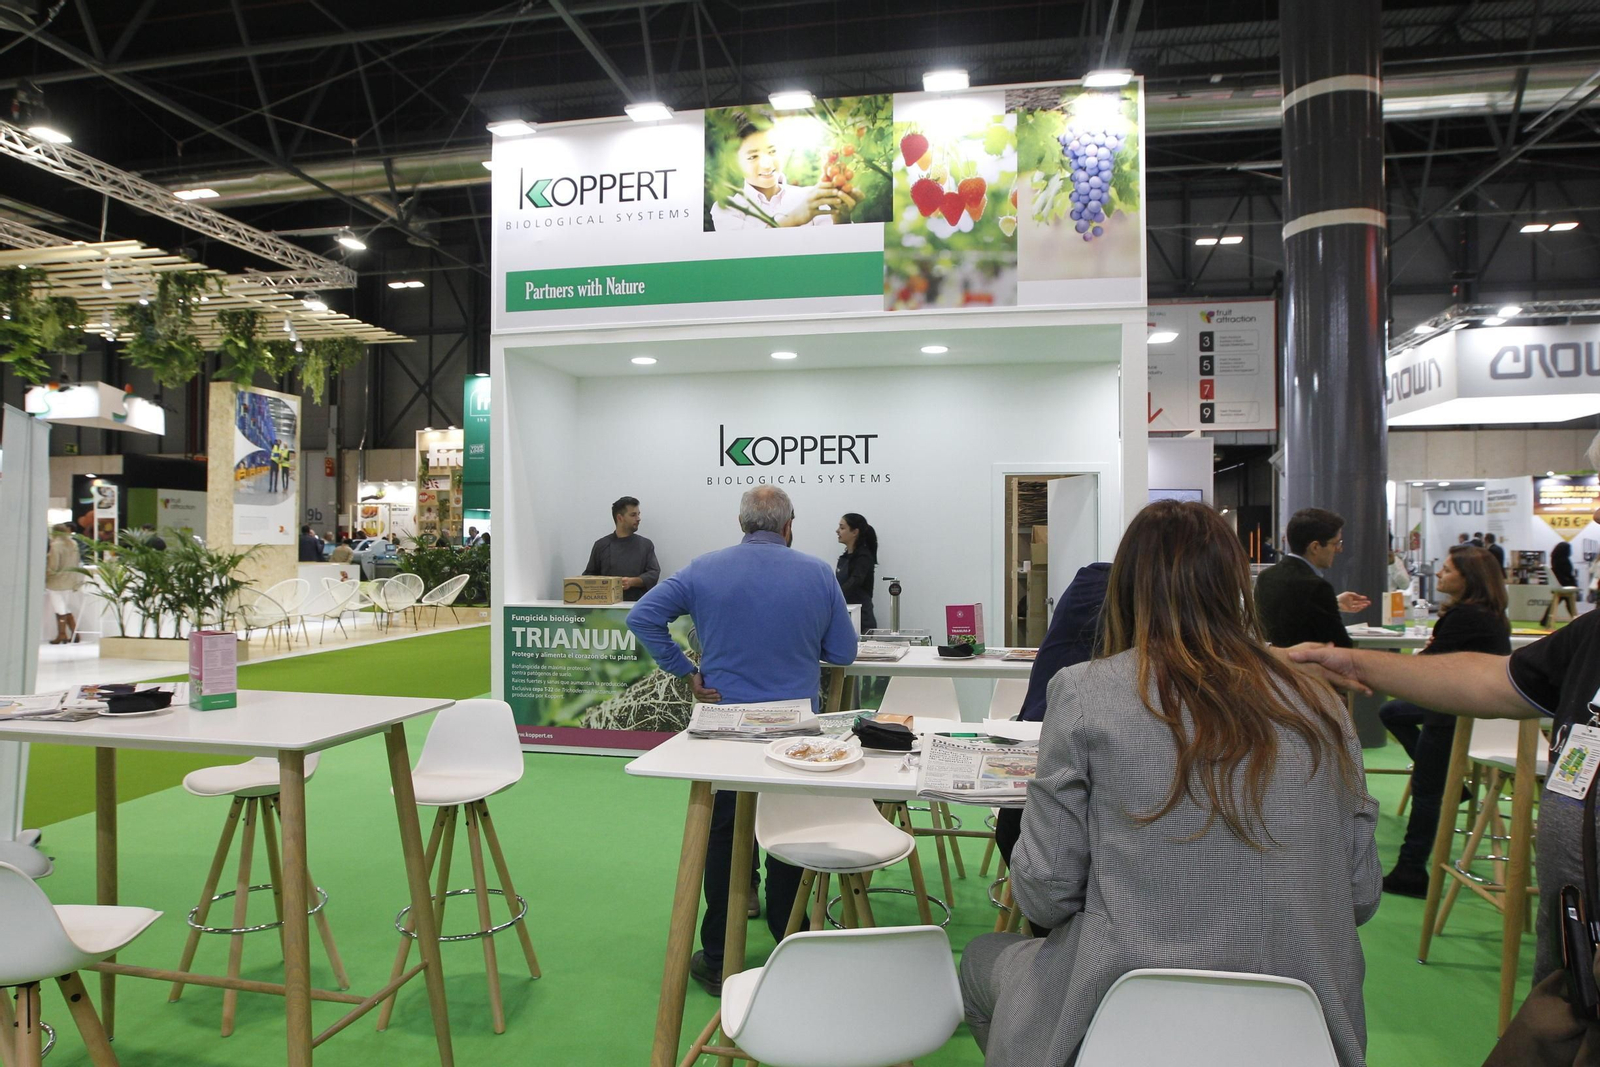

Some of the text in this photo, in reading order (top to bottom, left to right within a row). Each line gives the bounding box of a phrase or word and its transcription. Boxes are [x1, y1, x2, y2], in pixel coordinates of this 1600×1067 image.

[519, 168, 676, 210] KOPPERT
[506, 208, 690, 230] BIOLOGICAL SYSTEMS
[525, 277, 645, 300] Partners with Nature
[1203, 336, 1210, 347] 3
[1203, 360, 1210, 370] 5
[1204, 384, 1210, 395] 7
[1203, 408, 1211, 418] 9
[720, 424, 878, 466] KOPPERT
[706, 474, 891, 486] BIOLOGICAL SYSTEMS
[307, 508, 322, 521] 9b
[1551, 517, 1570, 526] 475
[1574, 517, 1580, 526] €
[512, 627, 636, 650] TRIANUM
